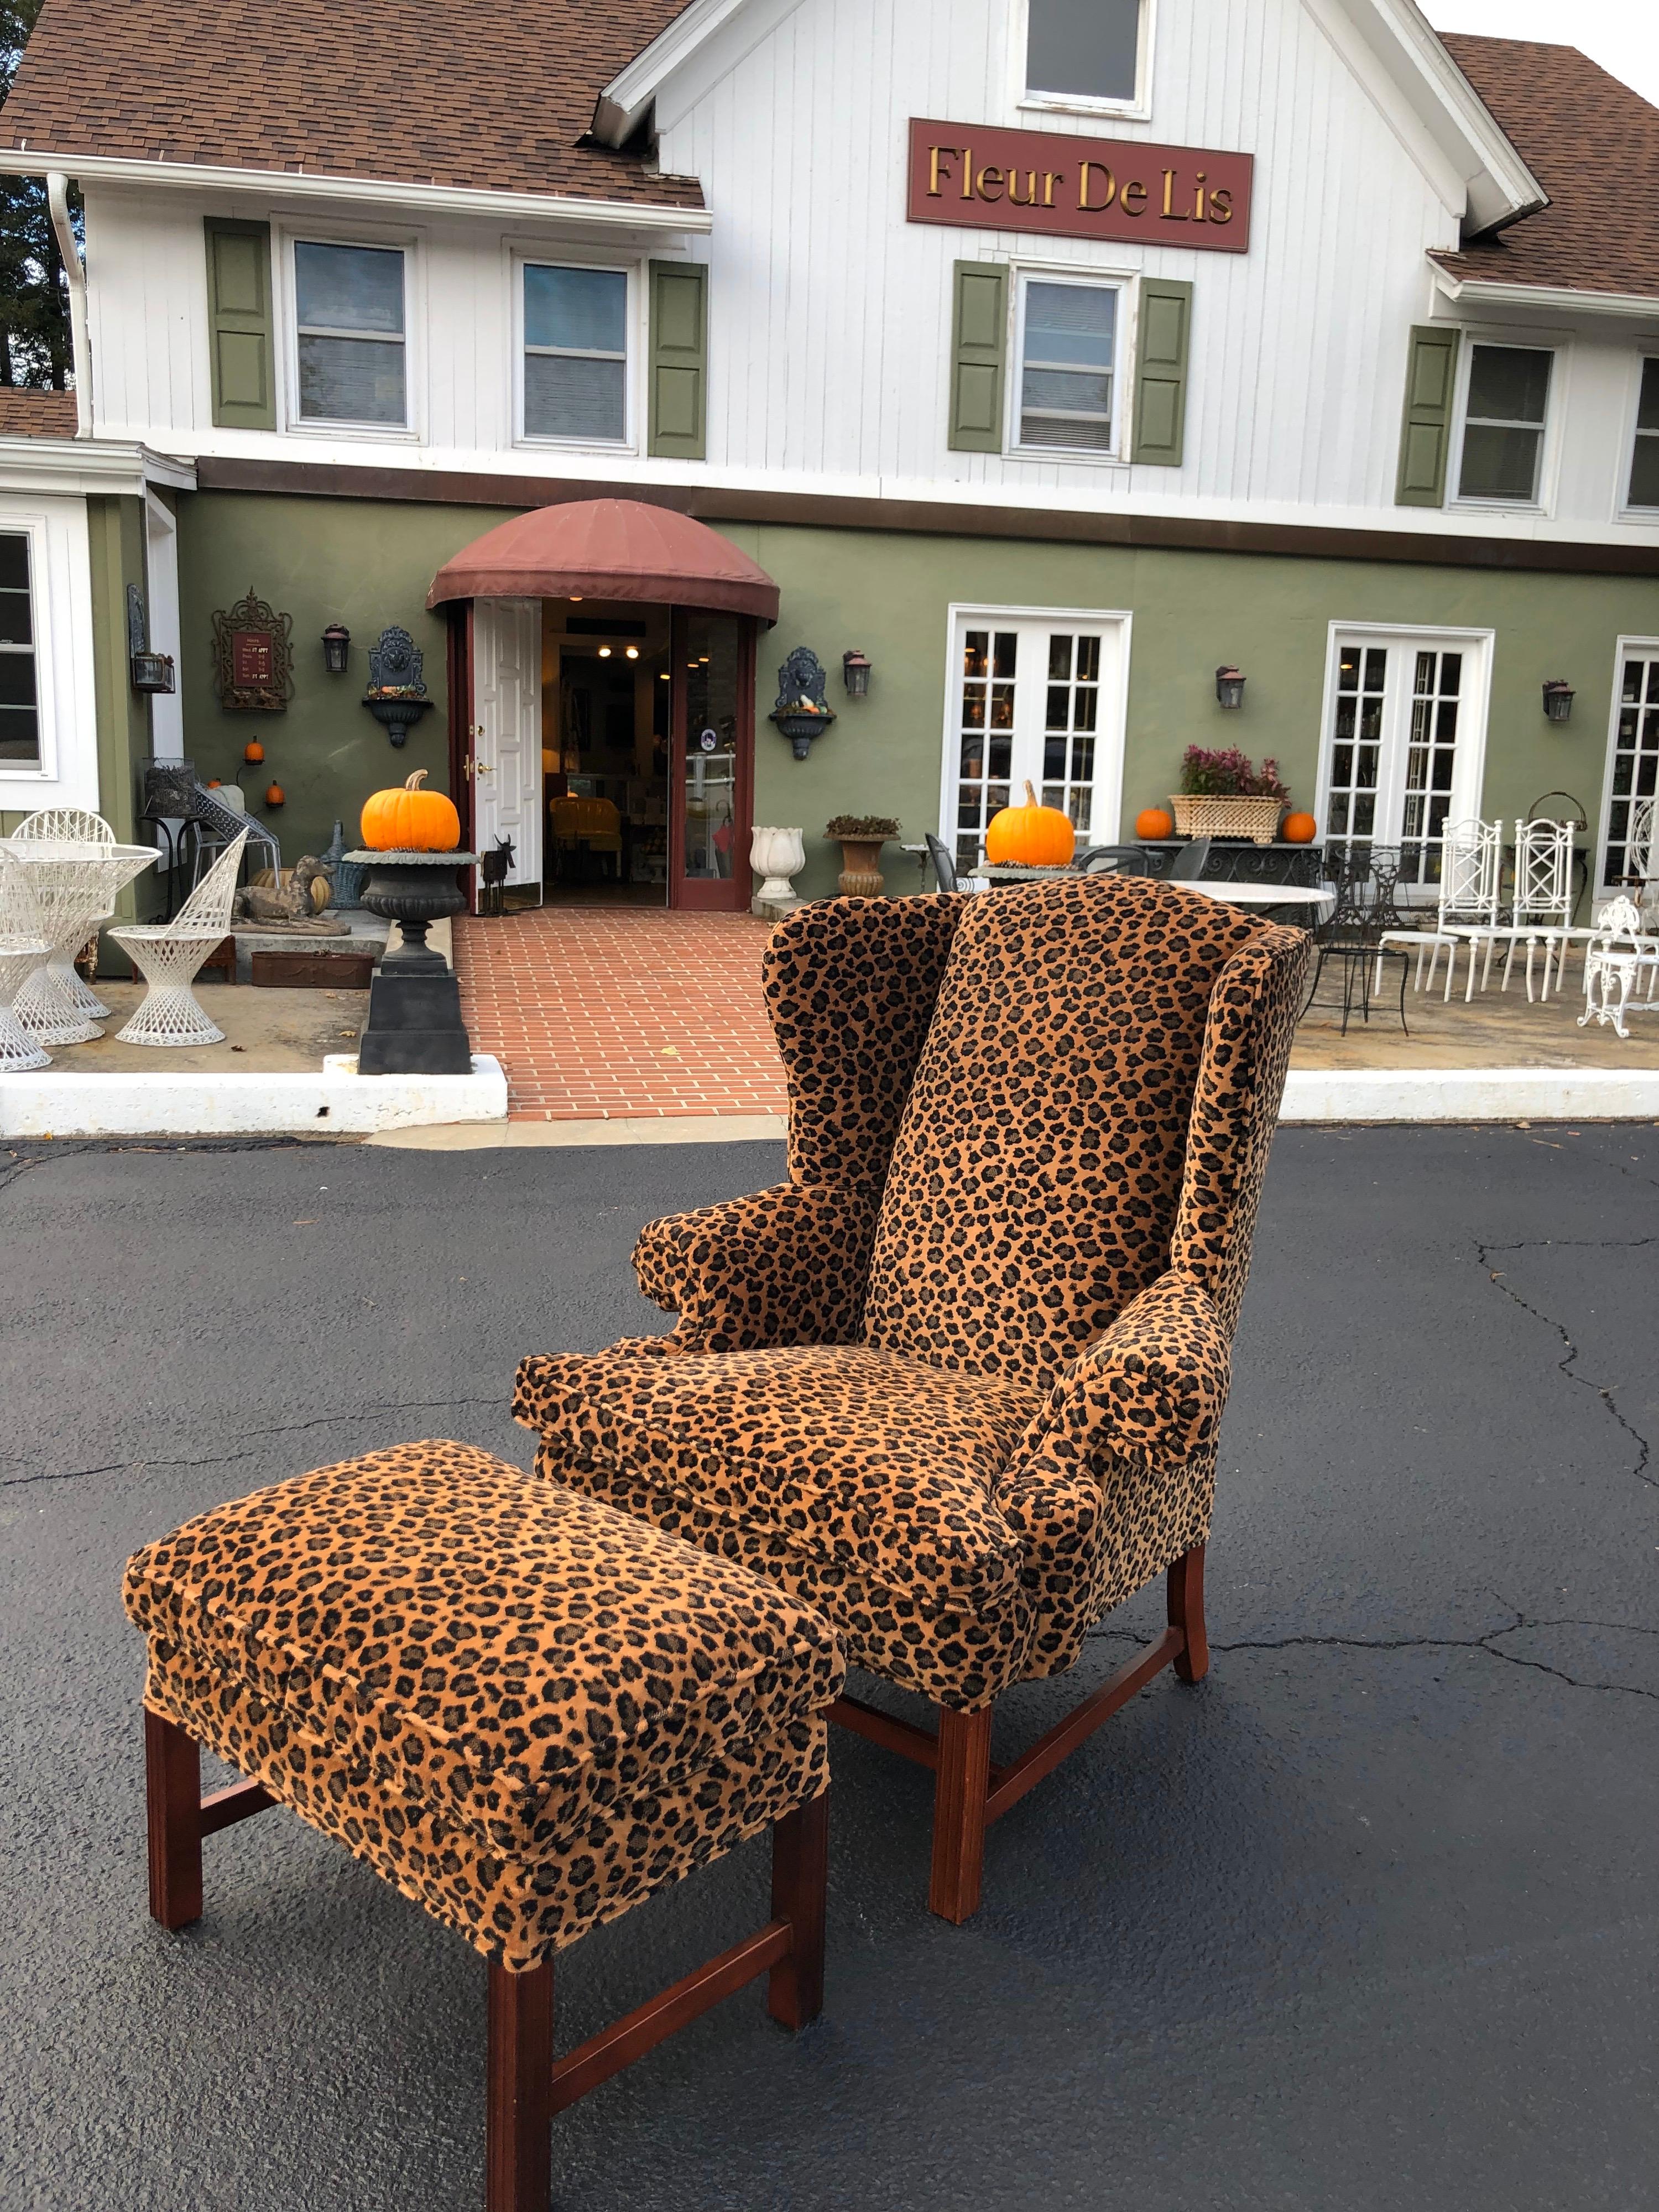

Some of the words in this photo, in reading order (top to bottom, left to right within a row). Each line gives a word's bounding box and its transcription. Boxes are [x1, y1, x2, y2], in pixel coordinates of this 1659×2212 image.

[926, 145, 1065, 209] Fleur
[1076, 160, 1147, 217] De
[1159, 169, 1234, 225] Lis
